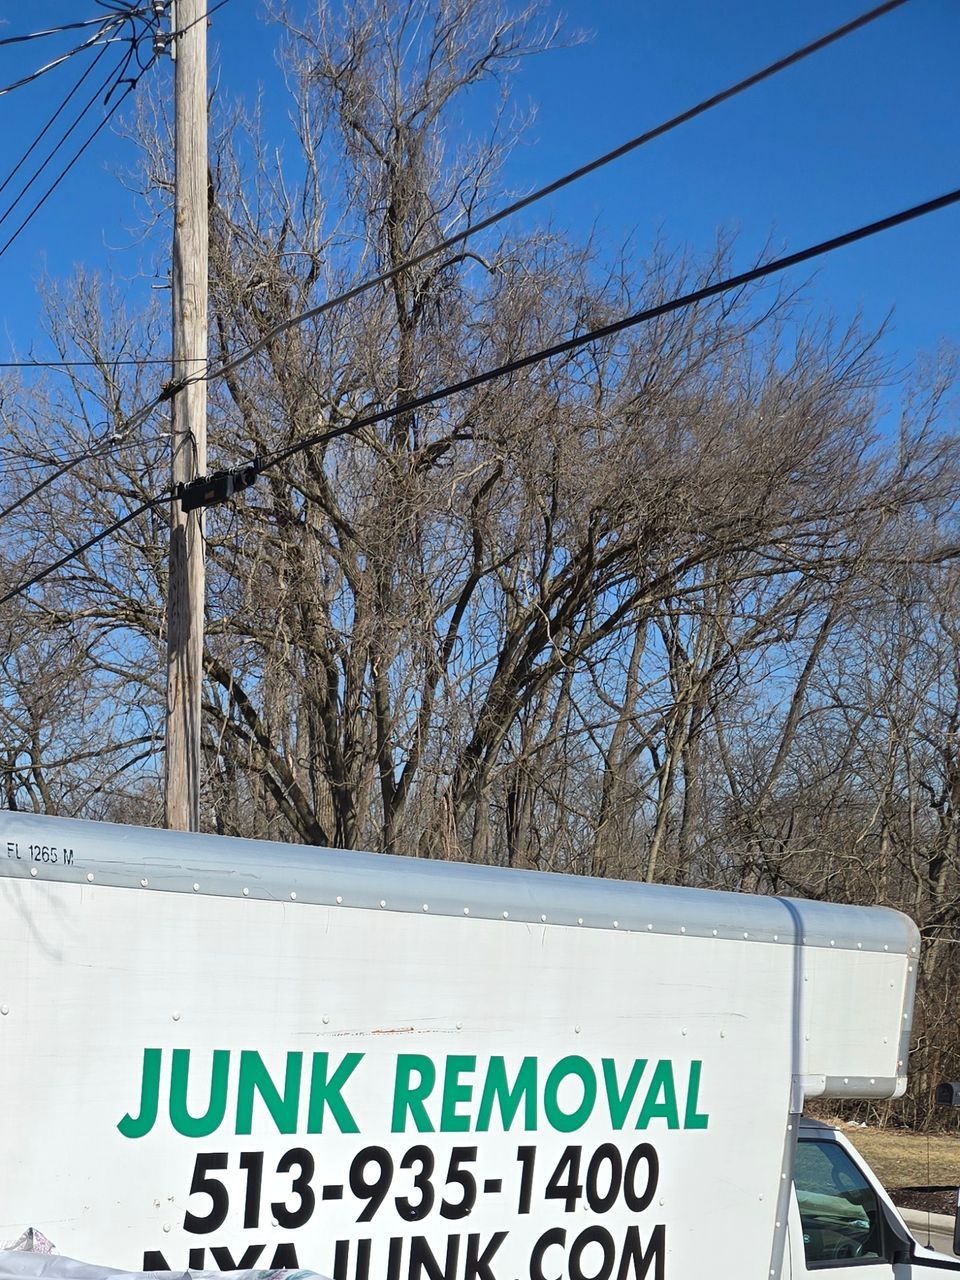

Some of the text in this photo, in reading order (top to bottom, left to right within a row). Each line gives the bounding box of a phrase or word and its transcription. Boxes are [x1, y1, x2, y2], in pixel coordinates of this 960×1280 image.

[28, 844, 58, 863] 1265
[63, 848, 74, 865] M
[116, 1048, 710, 1139] JUNK REMOVAL
[183, 1142, 659, 1235] 513-935-1400
